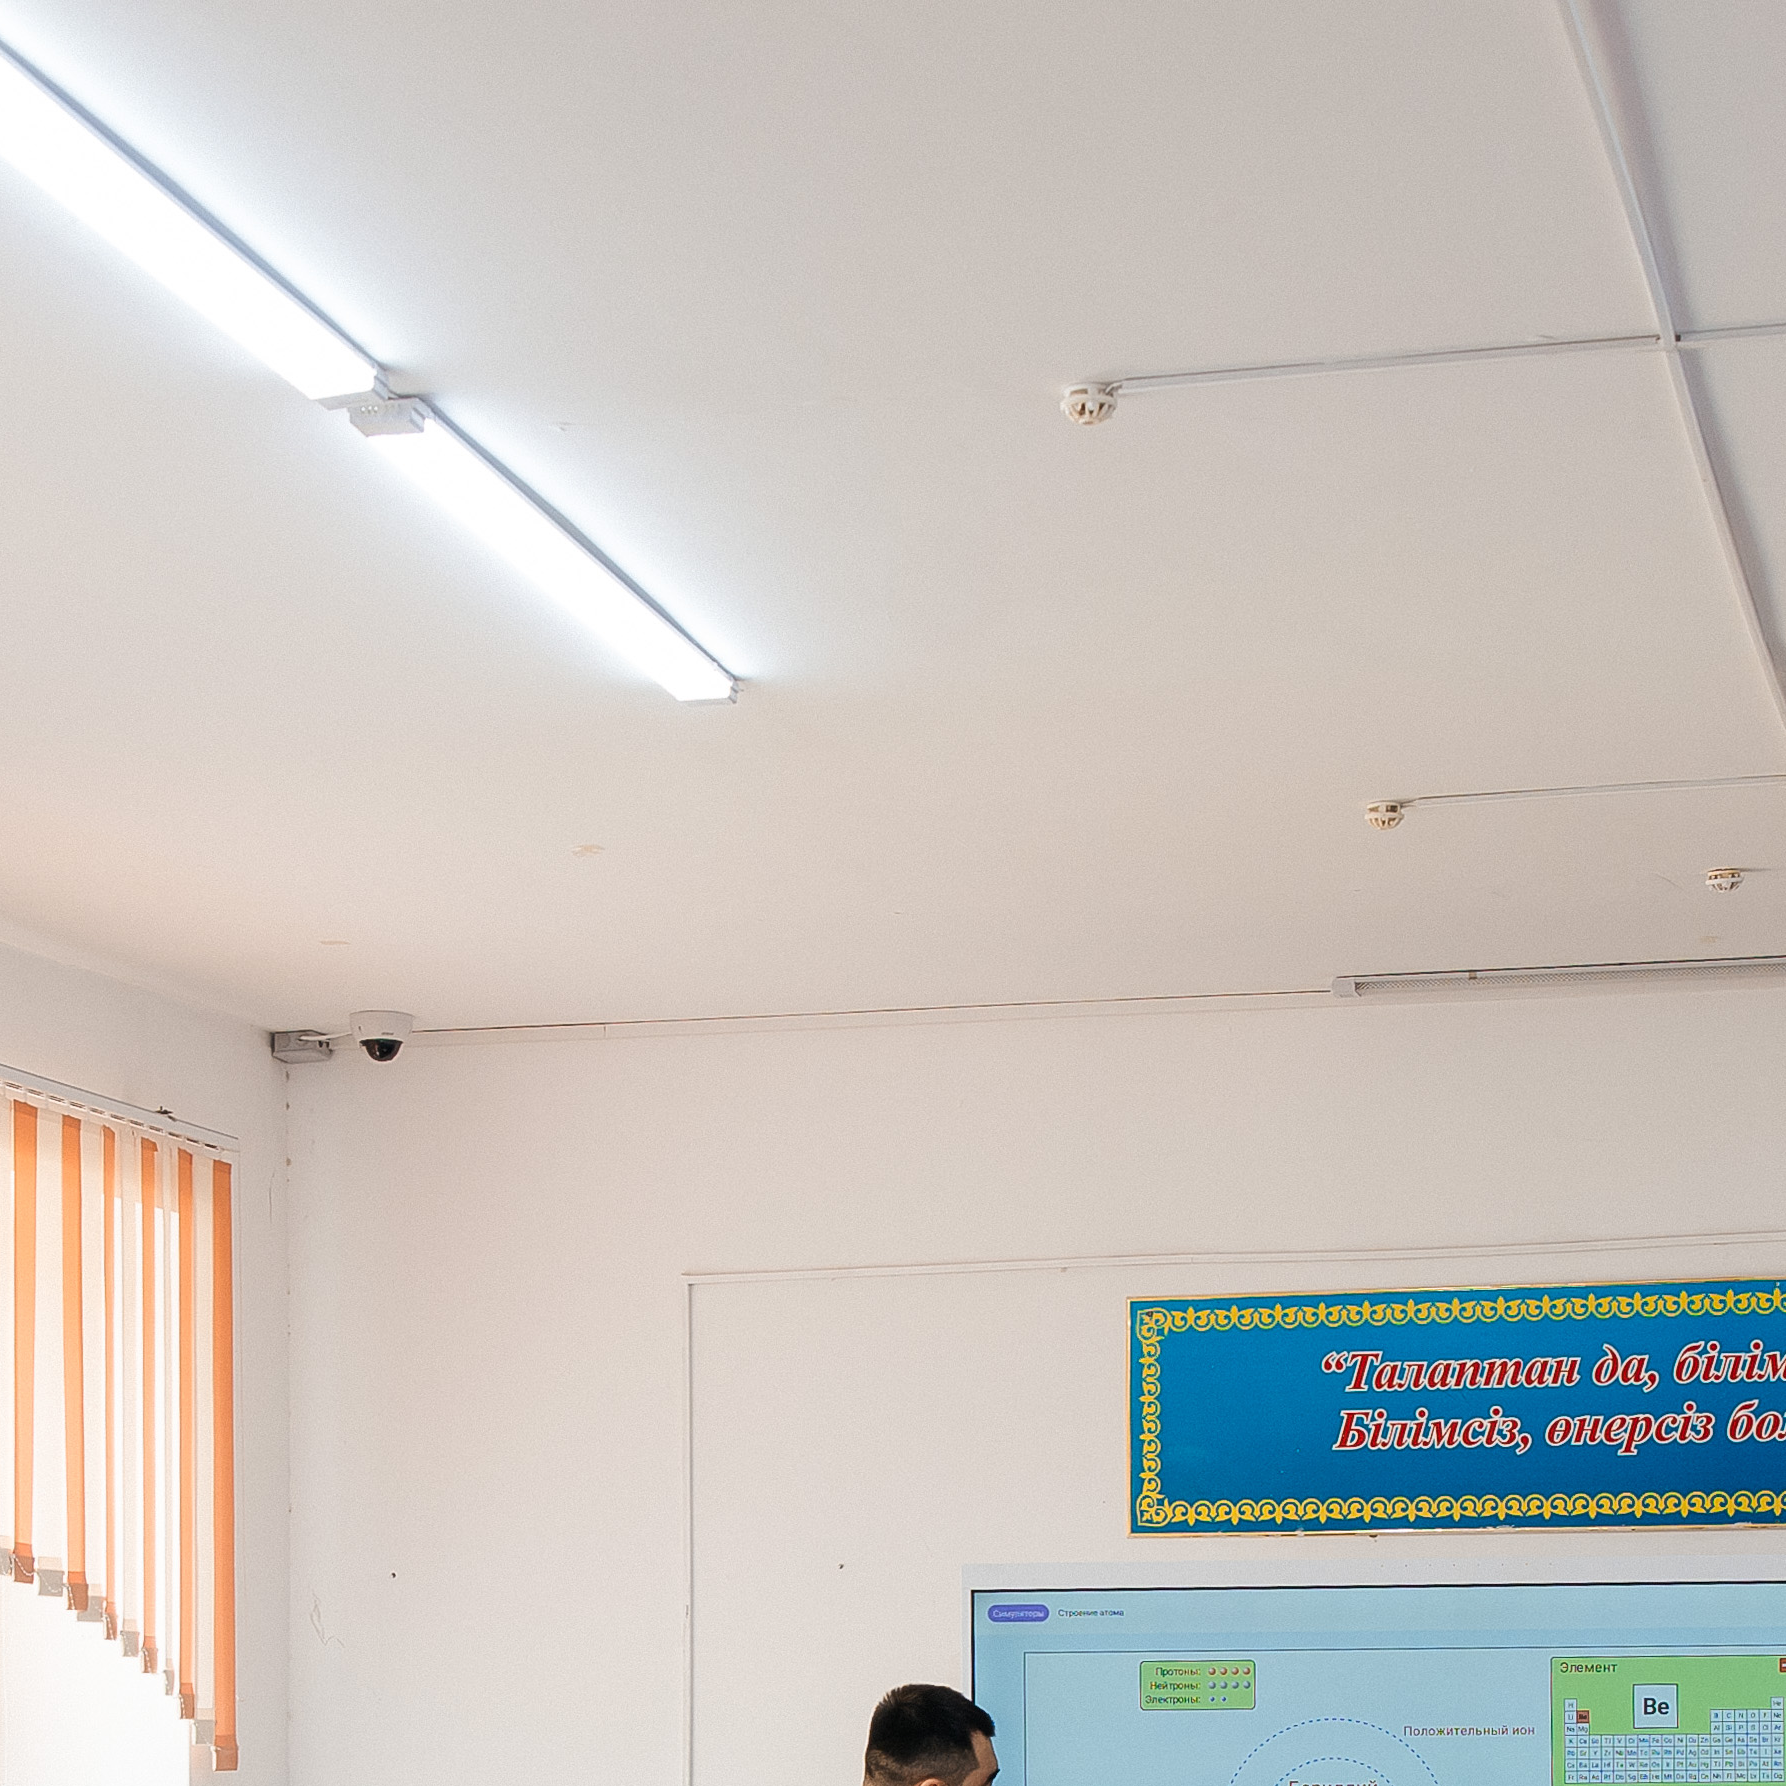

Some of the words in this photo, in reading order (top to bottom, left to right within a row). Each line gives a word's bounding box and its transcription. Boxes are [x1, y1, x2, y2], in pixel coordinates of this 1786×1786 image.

[1321, 1351, 1580, 1392] “Талаптан
[1593, 1345, 1660, 1393] да,
[1332, 1406, 1532, 1454] Білімсіз,
[1546, 1401, 1716, 1456] өнерсіз
[1058, 1609, 1097, 1617] Строение
[1155, 1667, 1200, 1677] Протоны:
[1559, 1661, 1618, 1674] Элемент
[1150, 1681, 1200, 1691] Нейтроны:
[1145, 1695, 1200, 1705] Электроны:
[1643, 1698, 1670, 1715] Be
[1403, 1725, 1509, 1736] Положительный
[1512, 1727, 1535, 1735] ион
